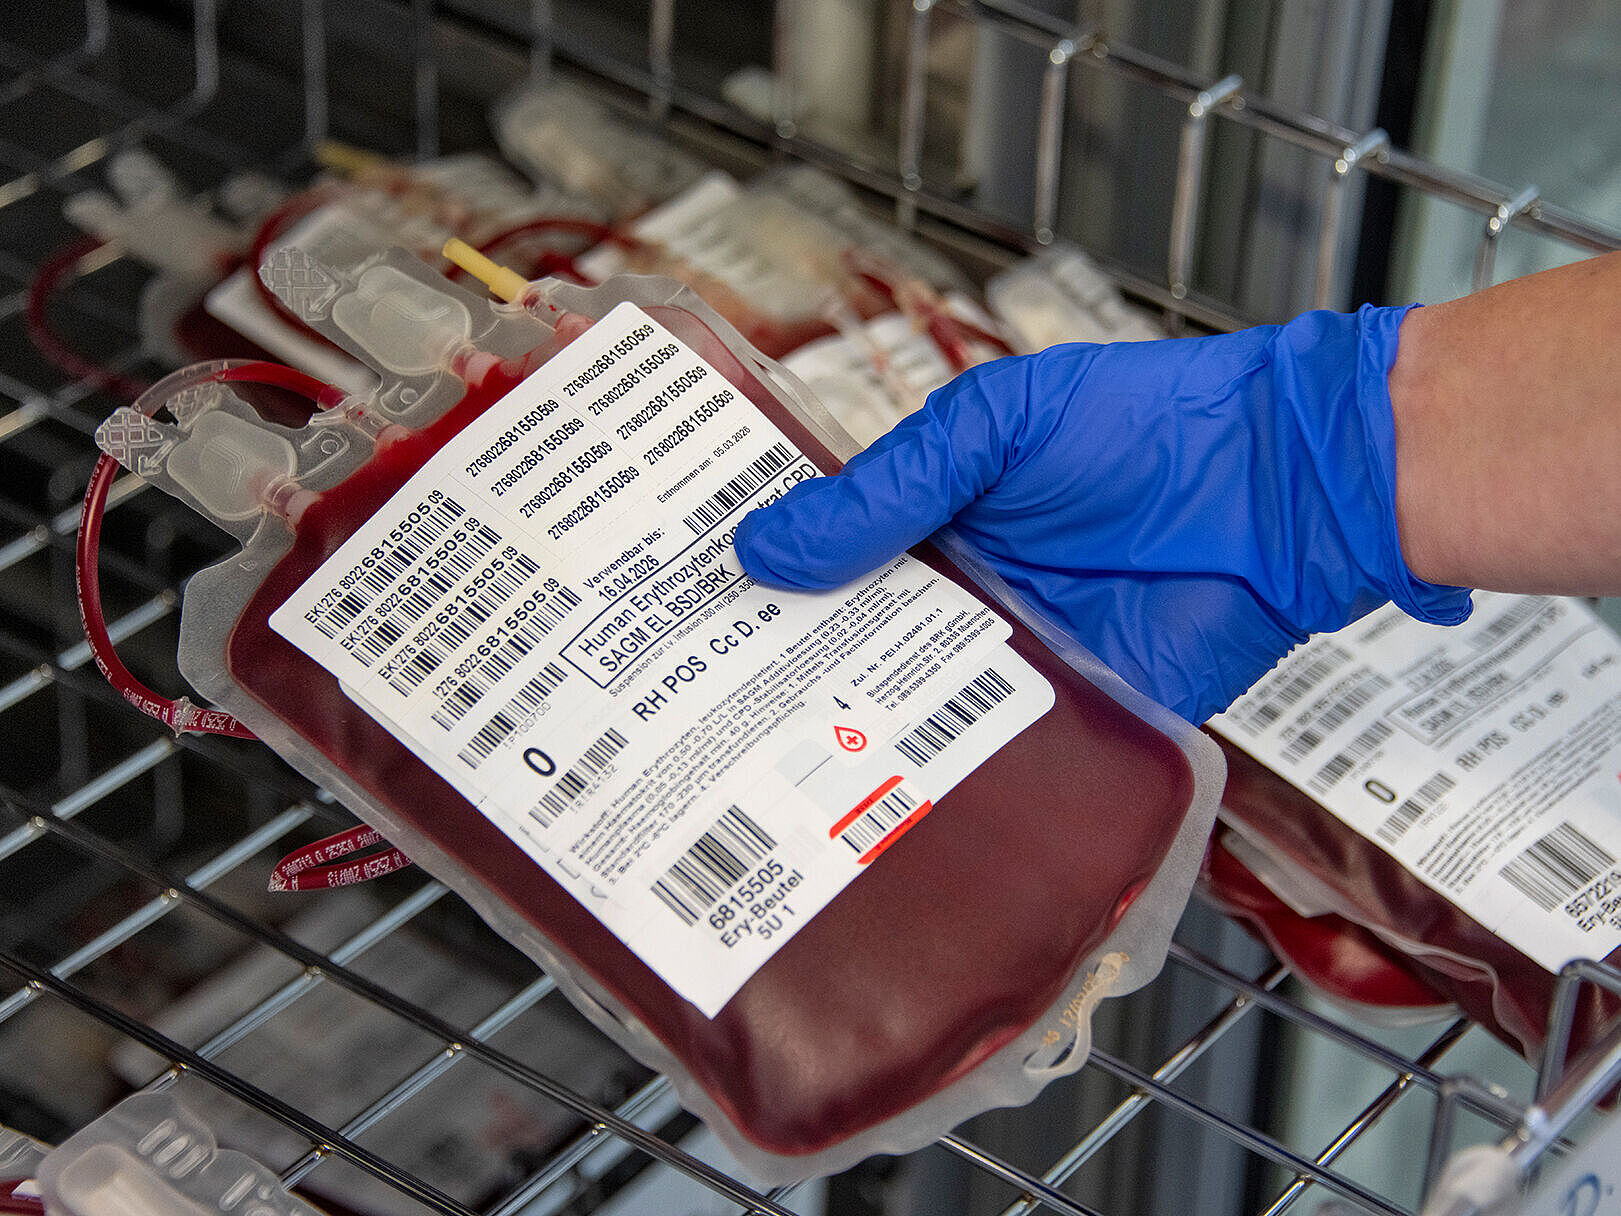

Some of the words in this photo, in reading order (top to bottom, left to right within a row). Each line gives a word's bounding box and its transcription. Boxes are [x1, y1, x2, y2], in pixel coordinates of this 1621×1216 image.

[562, 324, 655, 397] 2768022681550509
[587, 343, 679, 416] 2768022681550509
[465, 399, 559, 478] 2768022681550509
[615, 365, 707, 440] 2768022681550509
[642, 389, 734, 466] 2768022681550509
[490, 418, 584, 497] 2768022681550509
[519, 440, 613, 519] 2768022681550509
[656, 468, 700, 503] Entnommen
[698, 457, 714, 471] am:
[712, 425, 751, 458] 05.03.2026
[427, 489, 444, 504] 09
[463, 517, 480, 532] 09
[547, 465, 640, 540] 2768022681550509
[501, 545, 518, 560] 09
[542, 577, 560, 592] 09
[577, 608, 637, 657] Human
[780, 459, 818, 494] CPD
[582, 542, 644, 588] Verwendbar
[641, 527, 665, 546] bis:
[598, 554, 660, 601] 16.04.2026
[599, 626, 656, 672] SAGM
[643, 613, 673, 633] EL
[664, 563, 736, 618] BSD/BRK
[785, 632, 812, 655] Beutel
[812, 606, 846, 634] enthaelt:
[844, 566, 894, 608] Erythrozyten
[893, 554, 908, 570] mit
[956, 604, 990, 633] Muenchen
[608, 657, 653, 697] Suspension
[651, 646, 665, 660] zur
[672, 617, 704, 641] Infusion
[699, 607, 716, 620] 300
[713, 600, 726, 611] ml
[721, 590, 740, 606] (250
[631, 689, 668, 722] RH
[661, 655, 707, 694] POS
[709, 634, 739, 655] Cc
[732, 620, 760, 638] D.
[757, 603, 781, 622] ee
[729, 726, 741, 737] 40
[748, 688, 789, 719] Hinweise:
[795, 660, 824, 683] Mittels
[822, 599, 898, 660] Transfusionsgeraet
[896, 588, 911, 600] mit
[778, 675, 822, 709] Gebrauchs
[822, 658, 841, 675] -und
[839, 606, 903, 660] Fachinformation
[850, 673, 869, 687] Zul.
[866, 662, 882, 673] Nr.
[865, 651, 921, 698] Blutspendedienst
[918, 641, 932, 653] des
[929, 629, 946, 643] BRK
[884, 700, 898, 711] Tel.
[940, 651, 955, 664] Fax
[657, 763, 673, 778] von
[726, 704, 737, 713] in
[736, 684, 763, 705] SAGM
[762, 638, 822, 686] Additivloesung
[715, 719, 733, 736] und
[732, 704, 752, 720] CPD
[832, 695, 851, 710] 4
[708, 700, 807, 782] Verschreibungspflichtig.
[708, 858, 784, 930] 6815505
[719, 868, 804, 948] Ery-Beutel
[782, 904, 795, 915] 1
